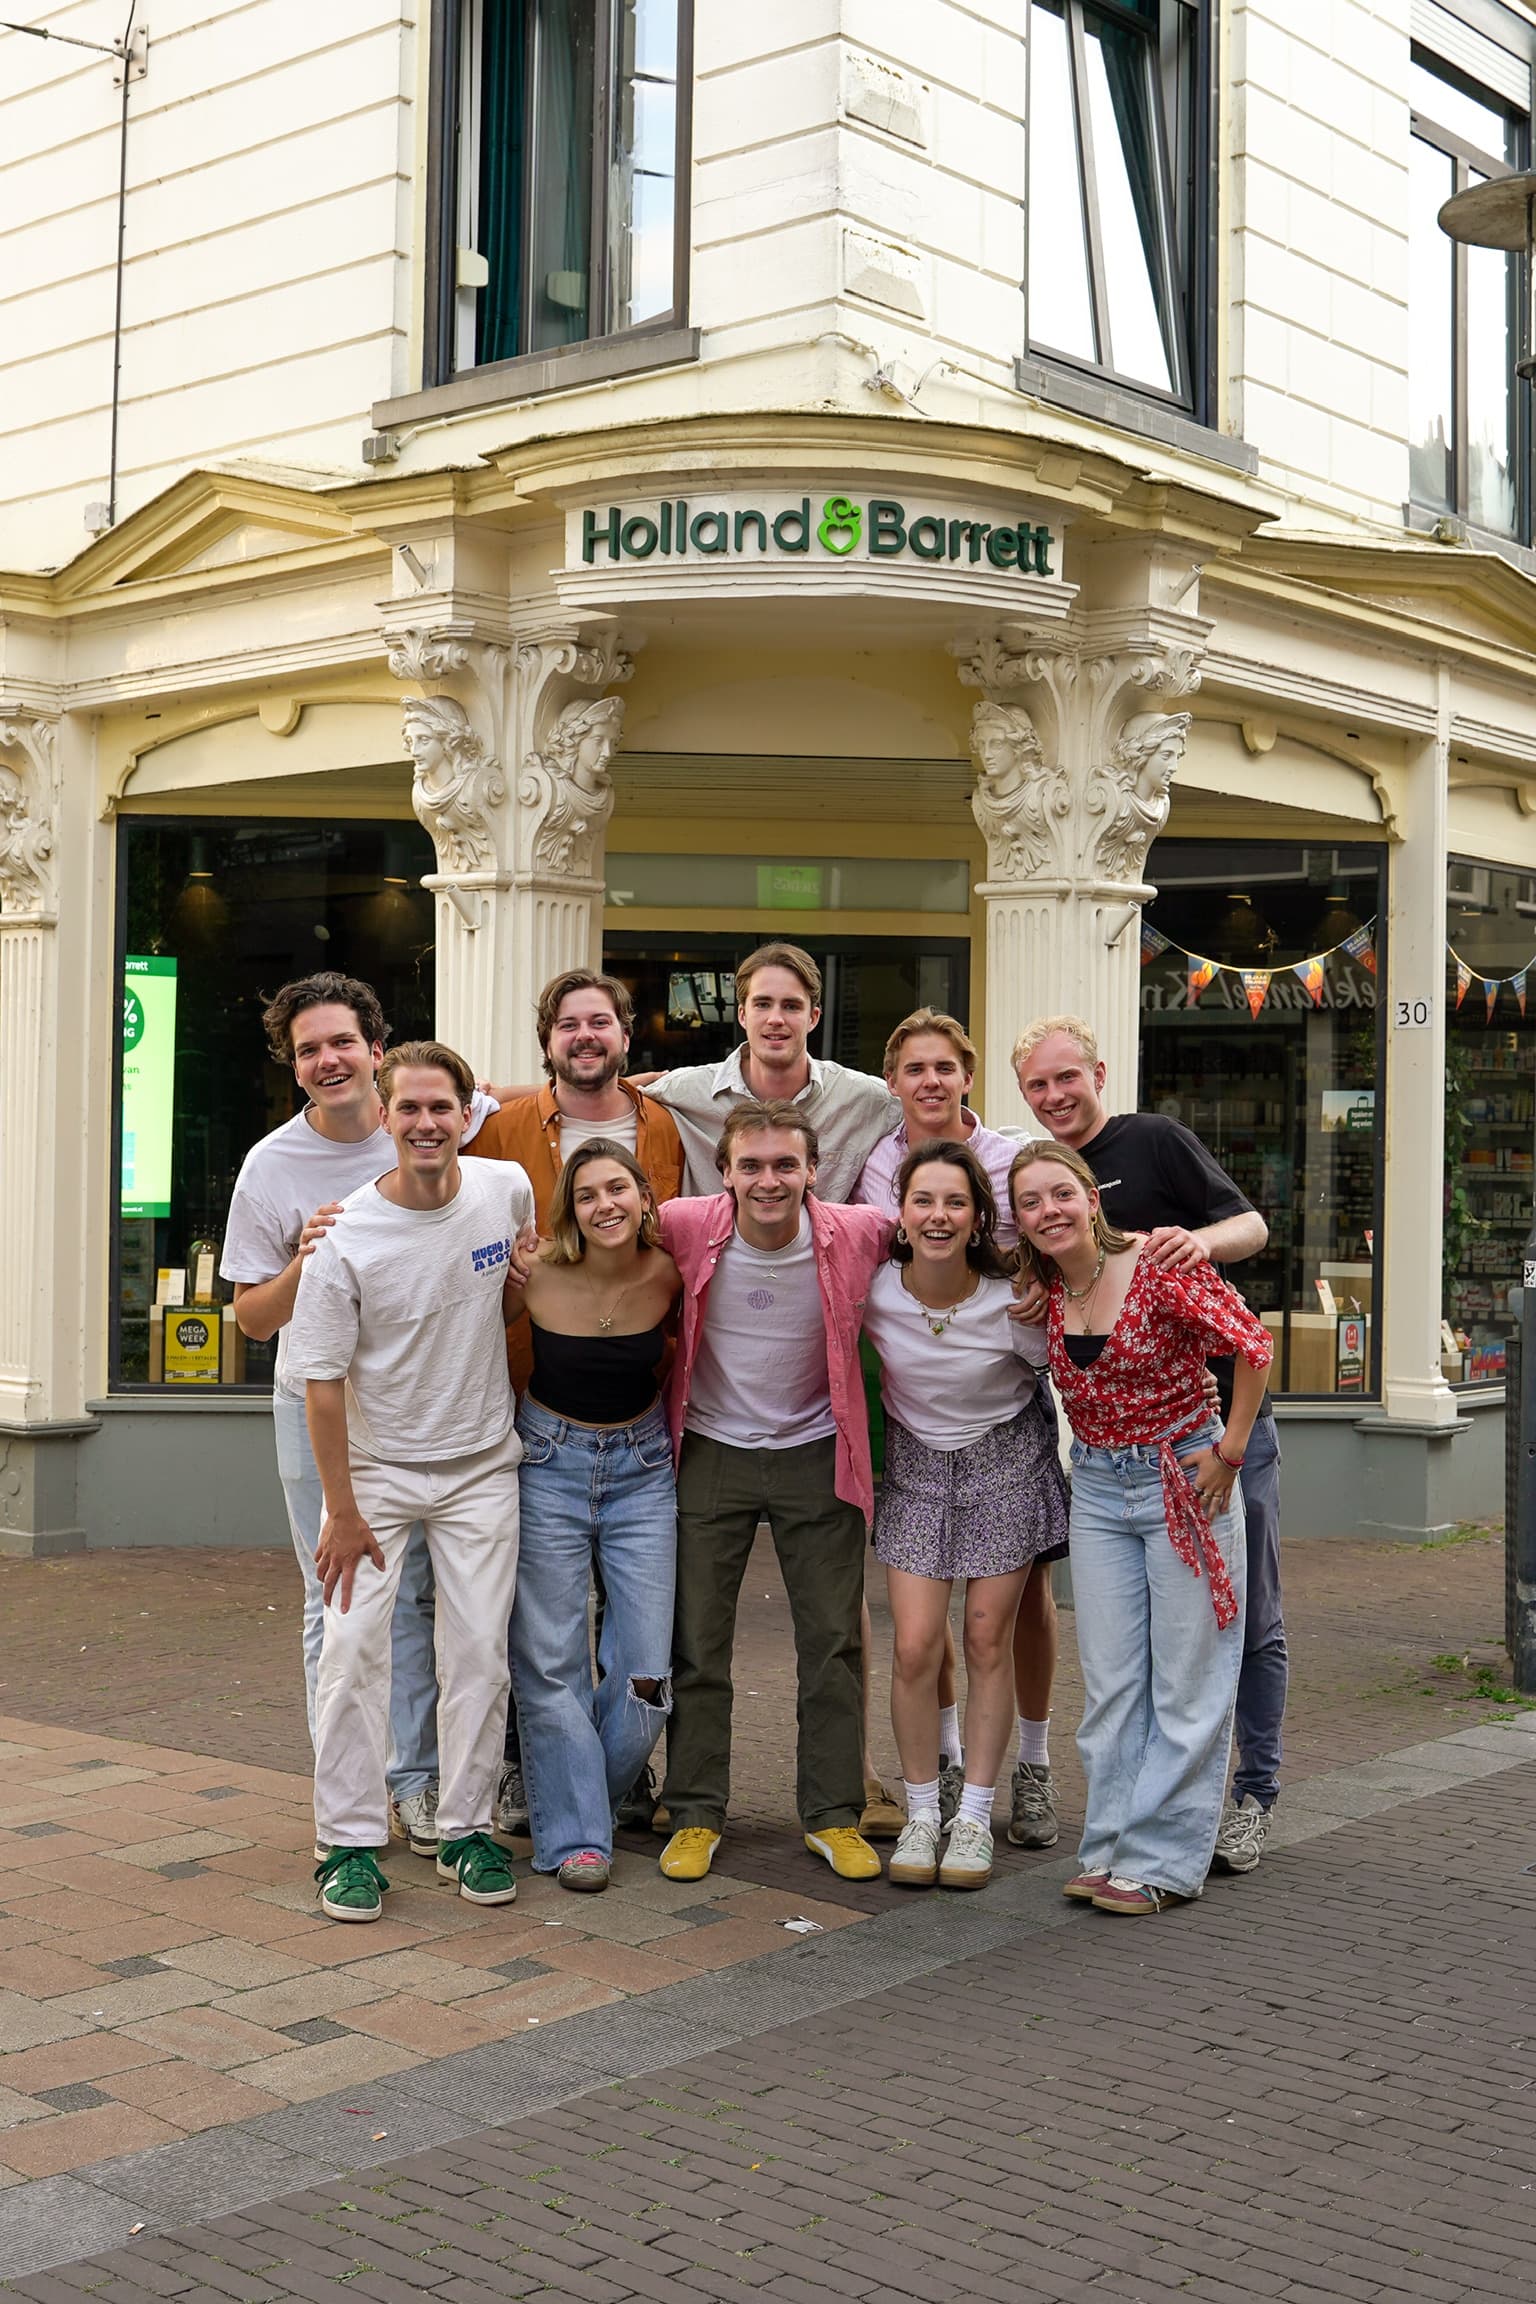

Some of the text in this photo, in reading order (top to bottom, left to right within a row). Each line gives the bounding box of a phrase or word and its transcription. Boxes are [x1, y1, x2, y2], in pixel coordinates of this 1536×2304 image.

[583, 497, 811, 563] Holland
[868, 499, 1055, 577] Barrett
[1398, 1002, 1428, 1026] 30
[471, 1240, 504, 1262] MUCHO
[474, 1260, 486, 1272] A
[487, 1249, 510, 1267] LOT
[180, 1325, 206, 1334] MEGA
[180, 1335, 205, 1343] WEEK
